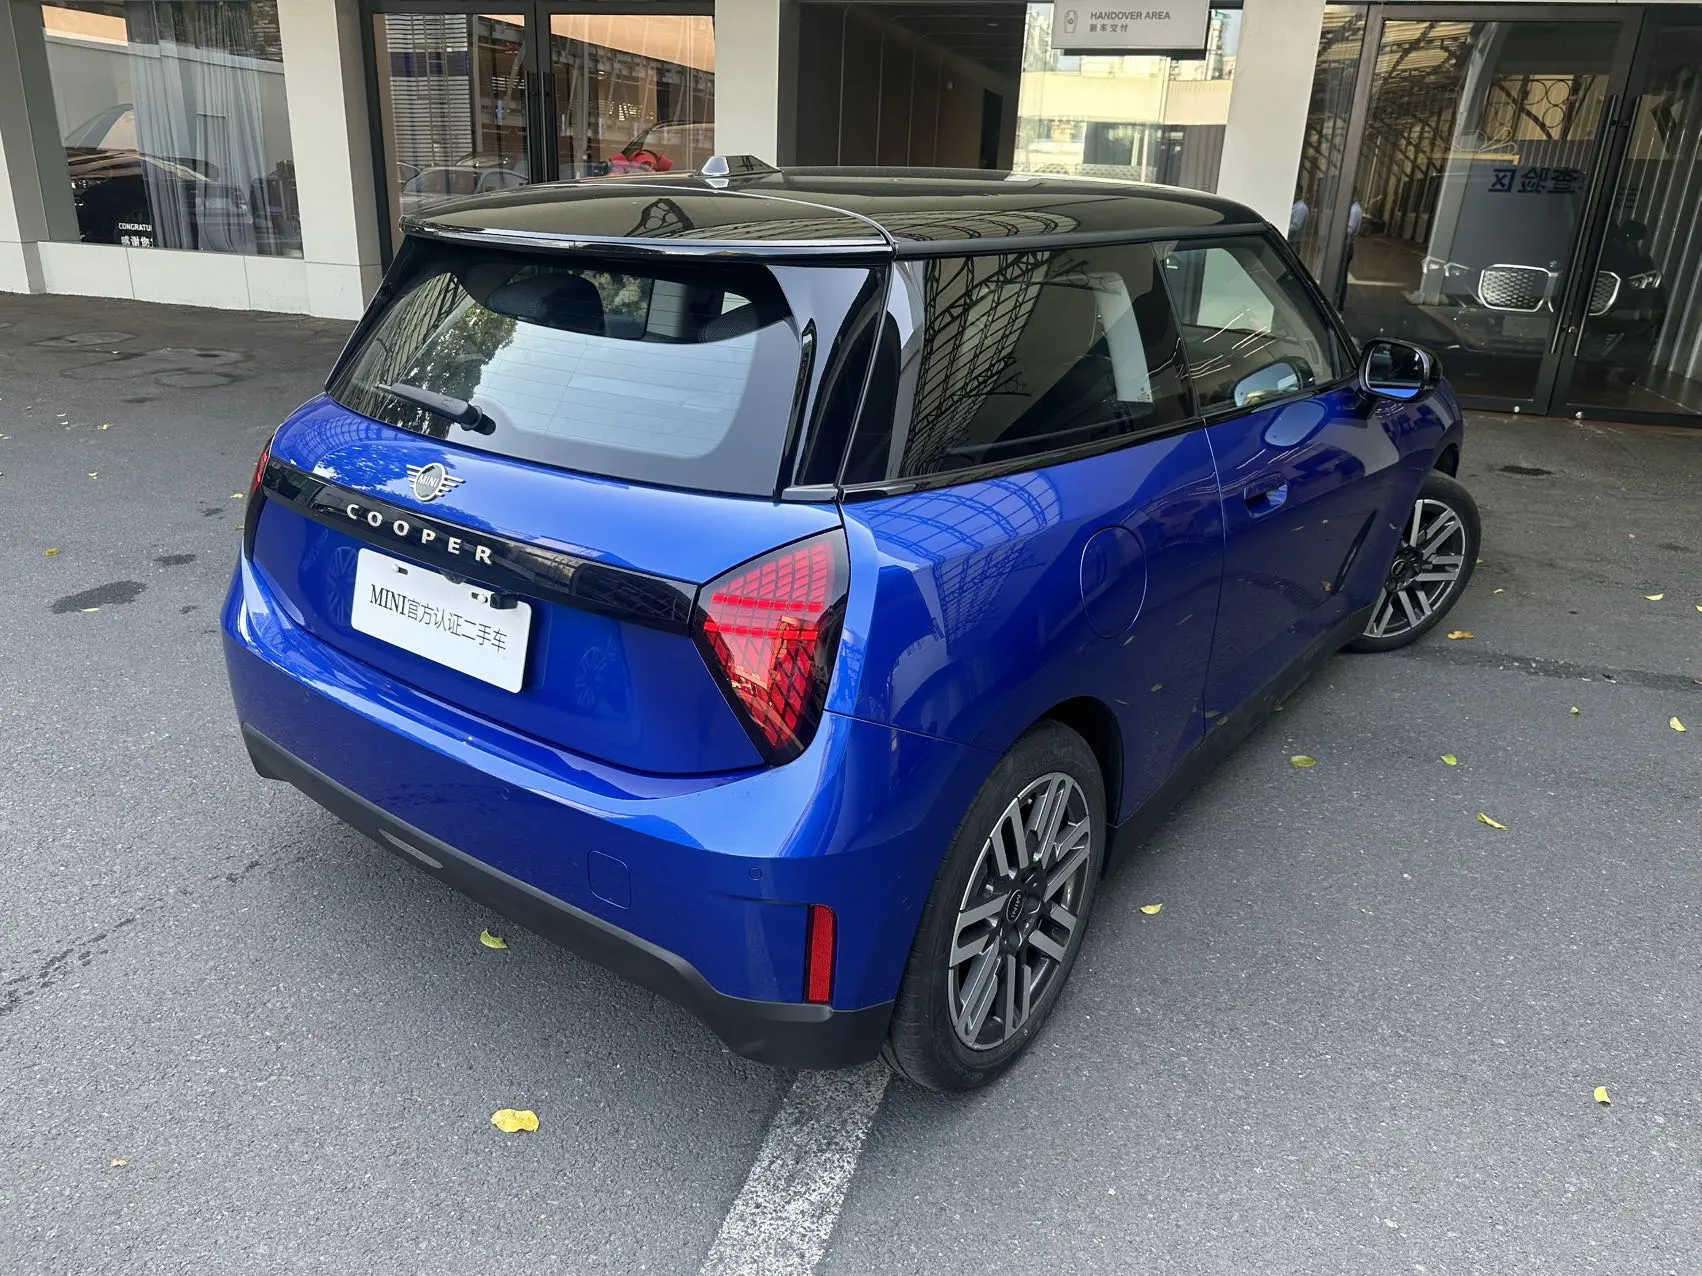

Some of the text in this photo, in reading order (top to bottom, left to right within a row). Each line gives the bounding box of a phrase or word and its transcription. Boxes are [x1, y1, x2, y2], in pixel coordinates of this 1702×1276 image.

[1090, 11, 1171, 20] HANDOVER AREA
[417, 472, 439, 488] MINI
[346, 503, 492, 565] COOPER
